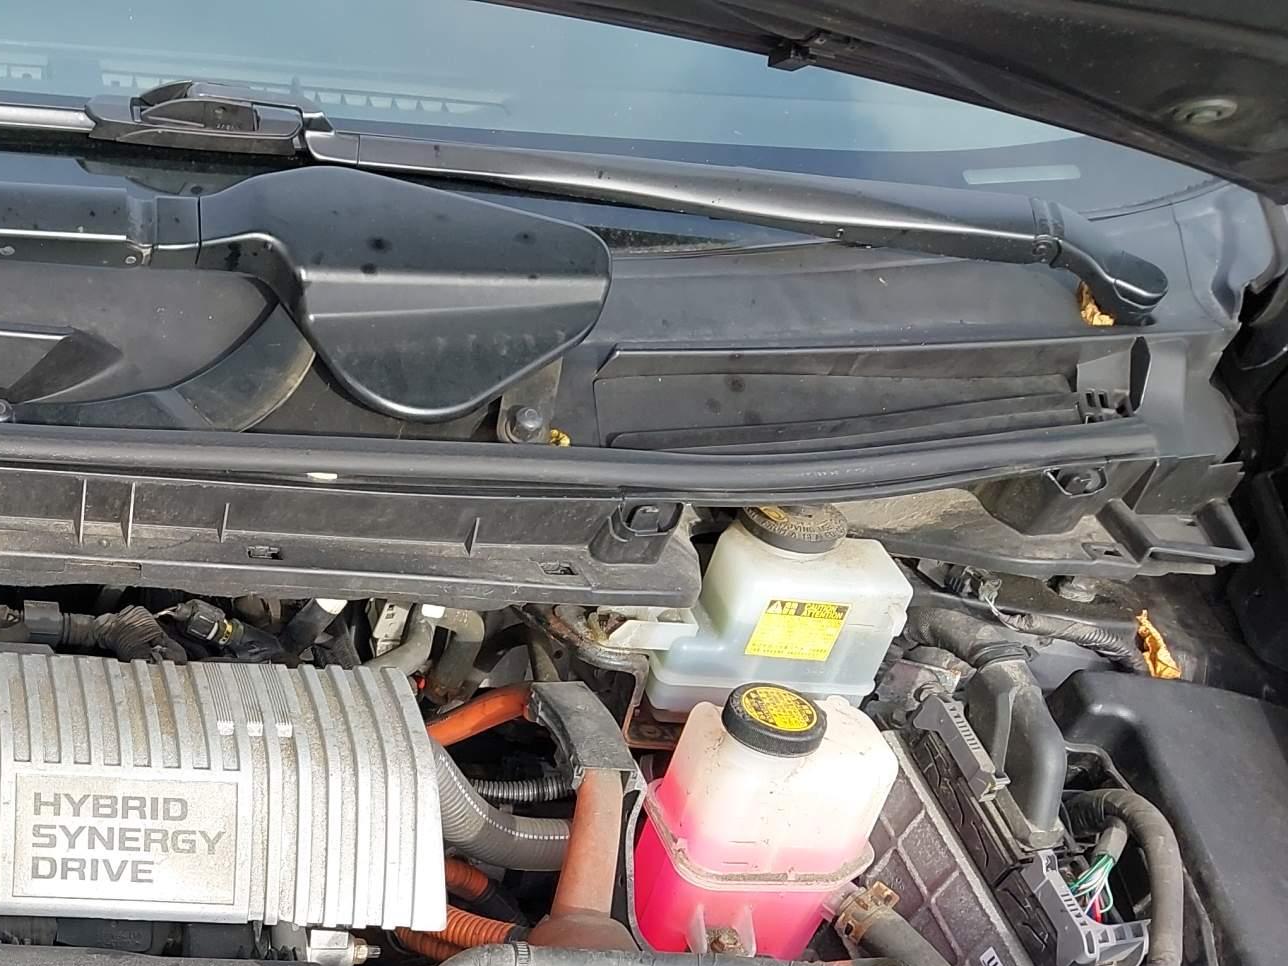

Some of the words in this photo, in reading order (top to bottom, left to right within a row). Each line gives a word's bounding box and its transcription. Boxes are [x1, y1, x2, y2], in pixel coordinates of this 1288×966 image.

[33, 792, 189, 821] HYBRID
[31, 824, 225, 855] SYNERGY
[31, 856, 155, 883] DRIVE
